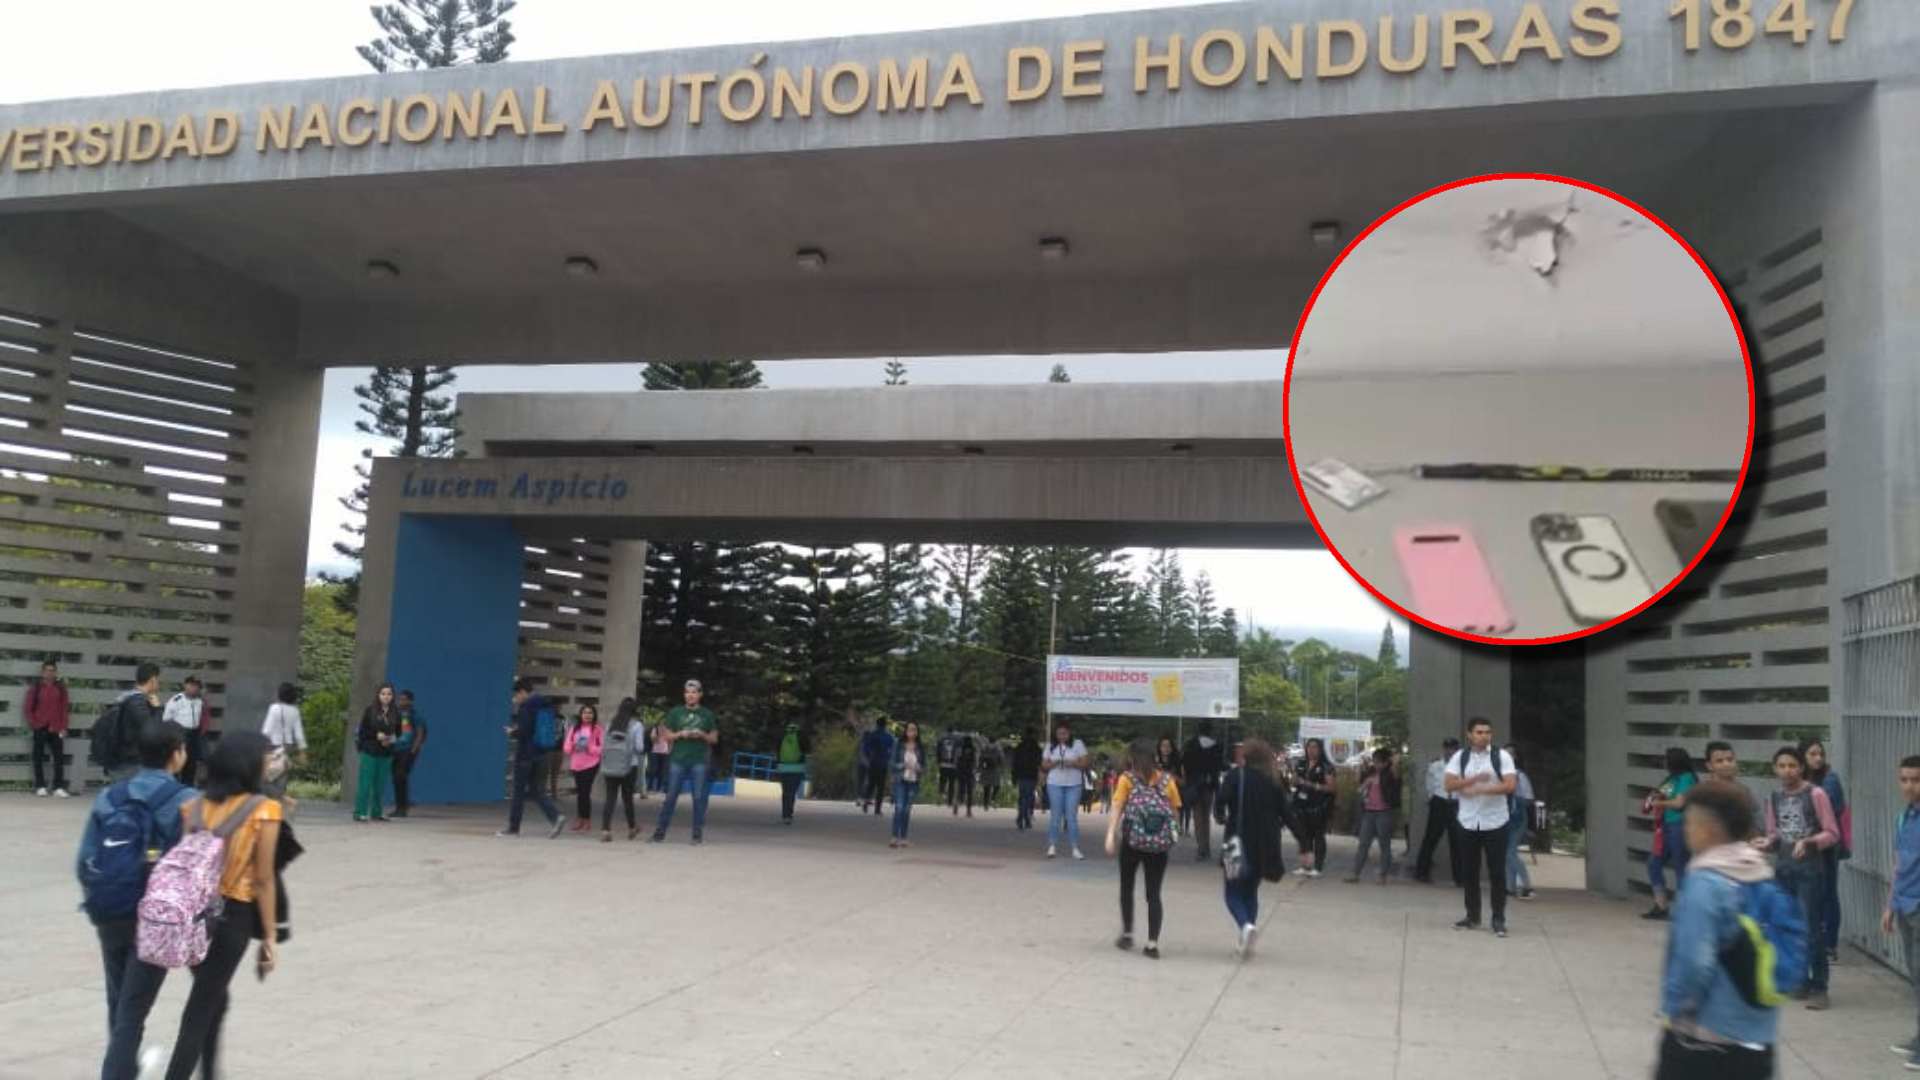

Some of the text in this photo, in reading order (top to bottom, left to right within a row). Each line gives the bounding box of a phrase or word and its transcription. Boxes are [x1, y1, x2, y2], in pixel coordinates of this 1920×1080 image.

[256, 85, 565, 152] NACIONAL
[582, 51, 984, 132] AUTÓNOMA
[1006, 40, 1104, 102] DE
[1132, 0, 1622, 92] HONDURAS
[1668, 0, 1855, 50] 1847
[402, 471, 629, 505] Lucem Aspicio
